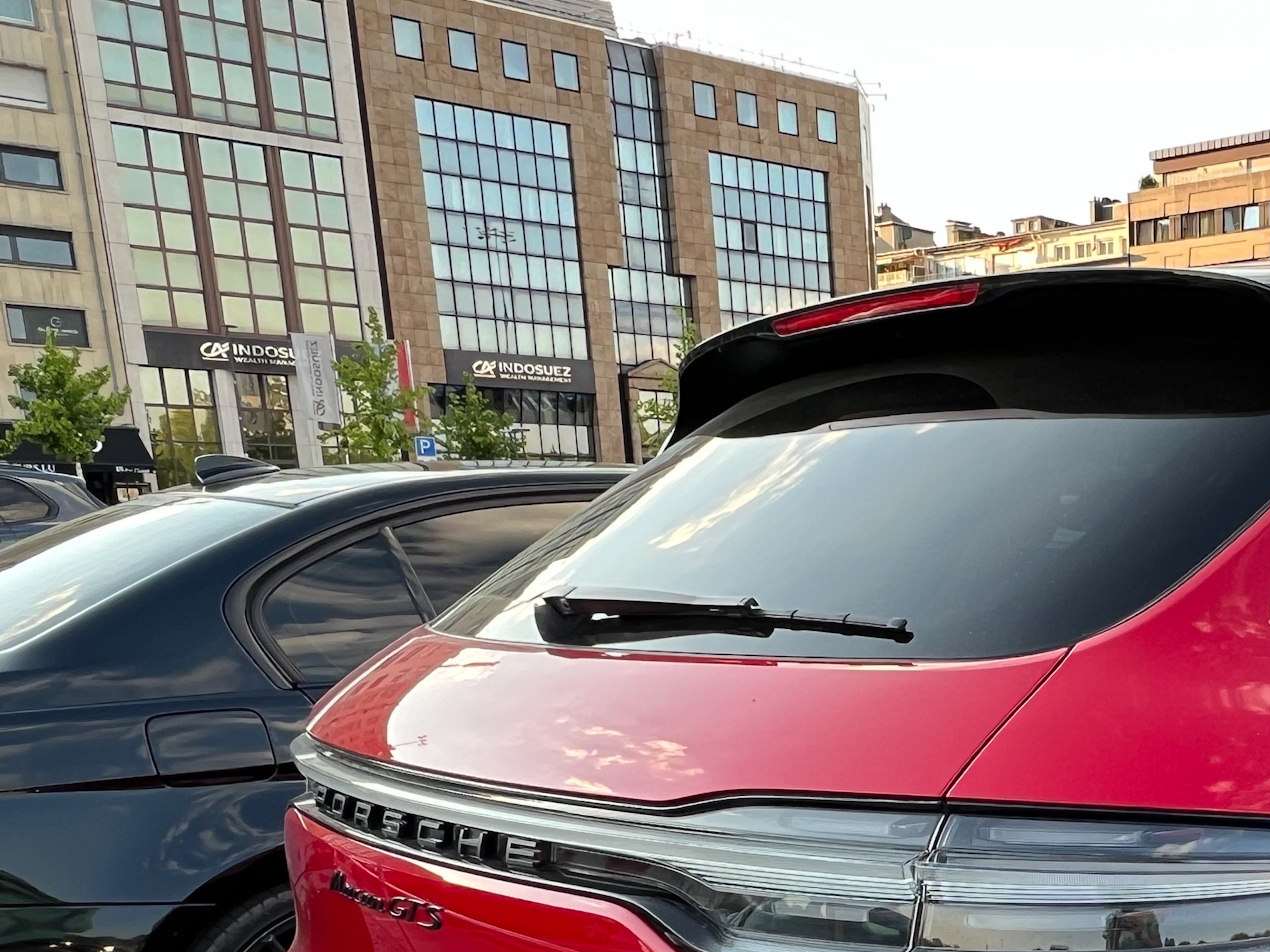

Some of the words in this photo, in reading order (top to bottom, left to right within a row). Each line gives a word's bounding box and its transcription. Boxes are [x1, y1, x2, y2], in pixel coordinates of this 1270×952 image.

[498, 361, 571, 377] INDOSUEZ
[420, 439, 431, 454] P
[316, 785, 541, 869] PORSCHE
[388, 895, 445, 931] GTS
